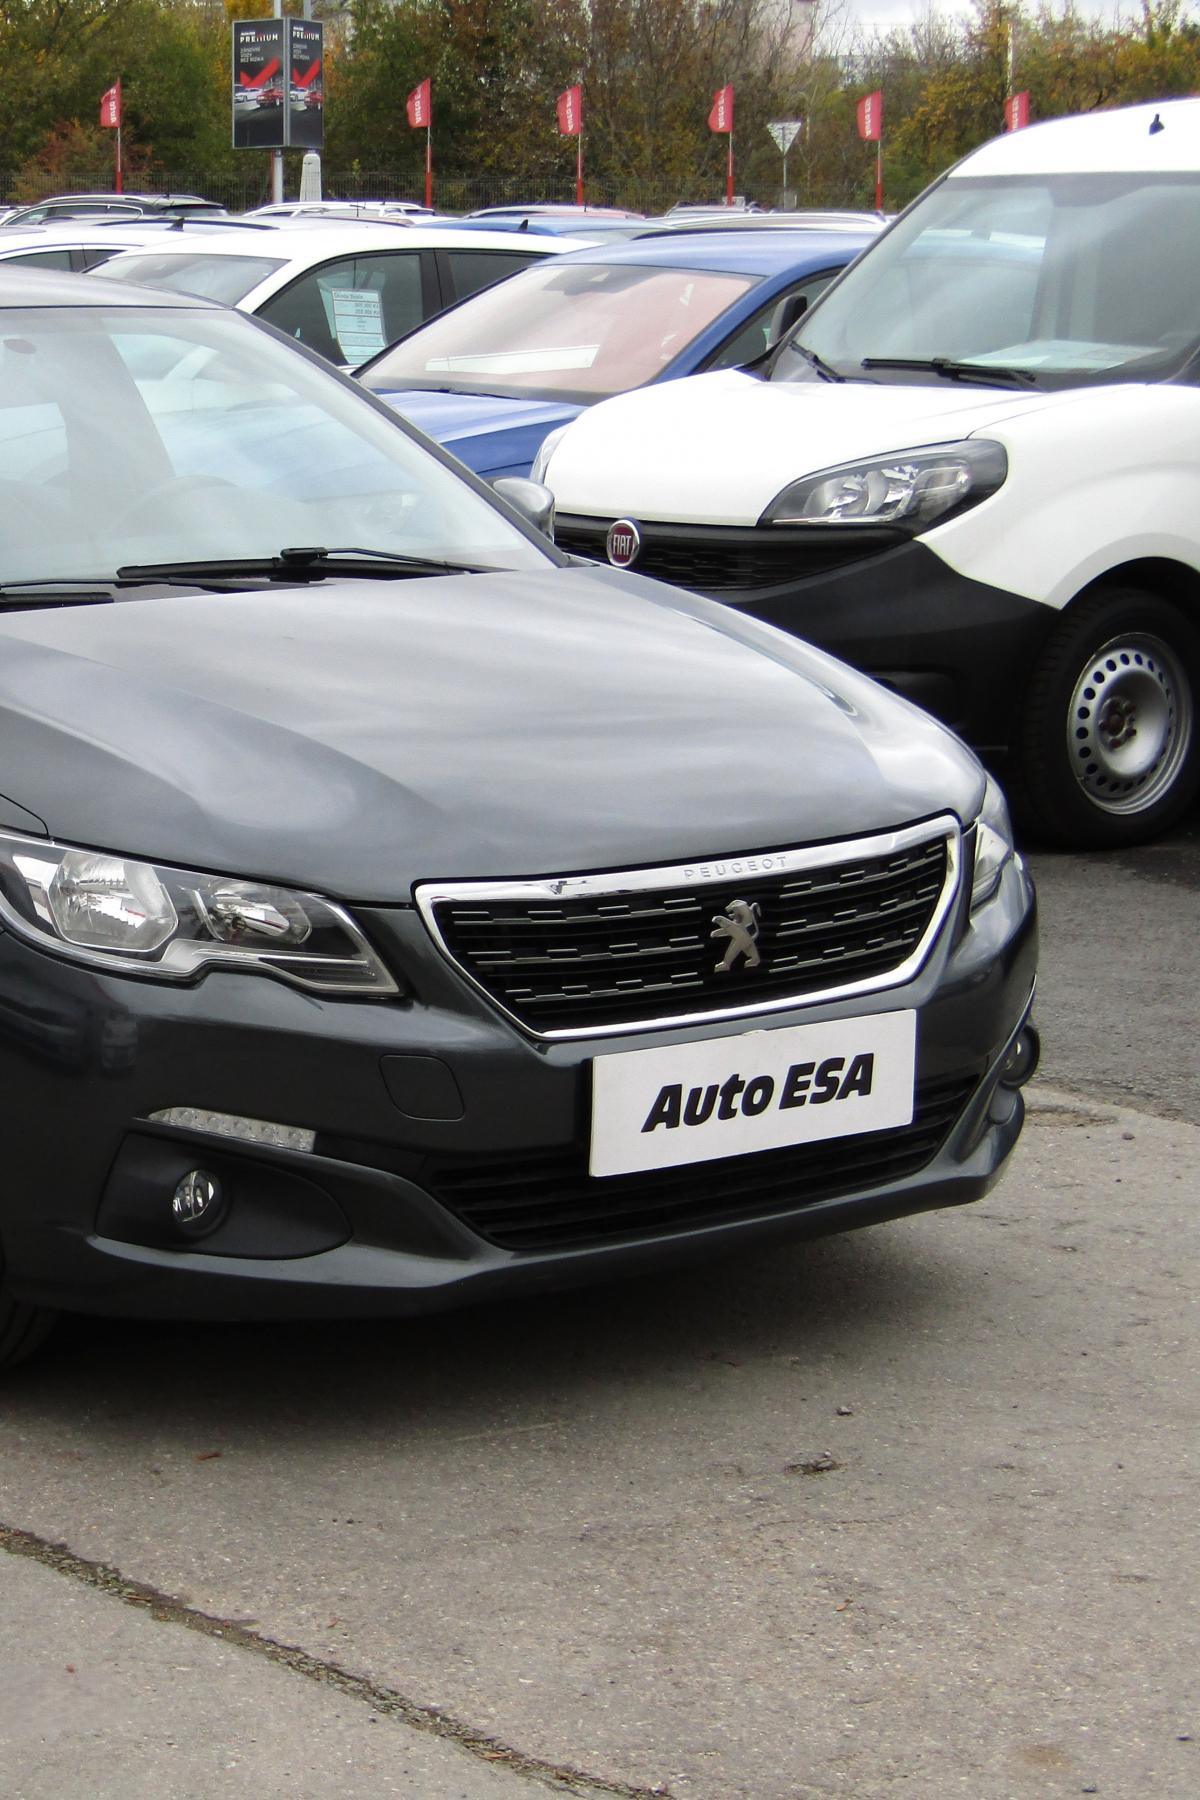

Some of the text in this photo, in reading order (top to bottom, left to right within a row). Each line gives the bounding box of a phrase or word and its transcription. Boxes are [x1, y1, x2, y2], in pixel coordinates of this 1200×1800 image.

[240, 34, 278, 43] PREMIUM
[613, 534, 632, 555] FIAT
[684, 857, 786, 879] PEUGEOT
[641, 1052, 875, 1133] Auto ESA
